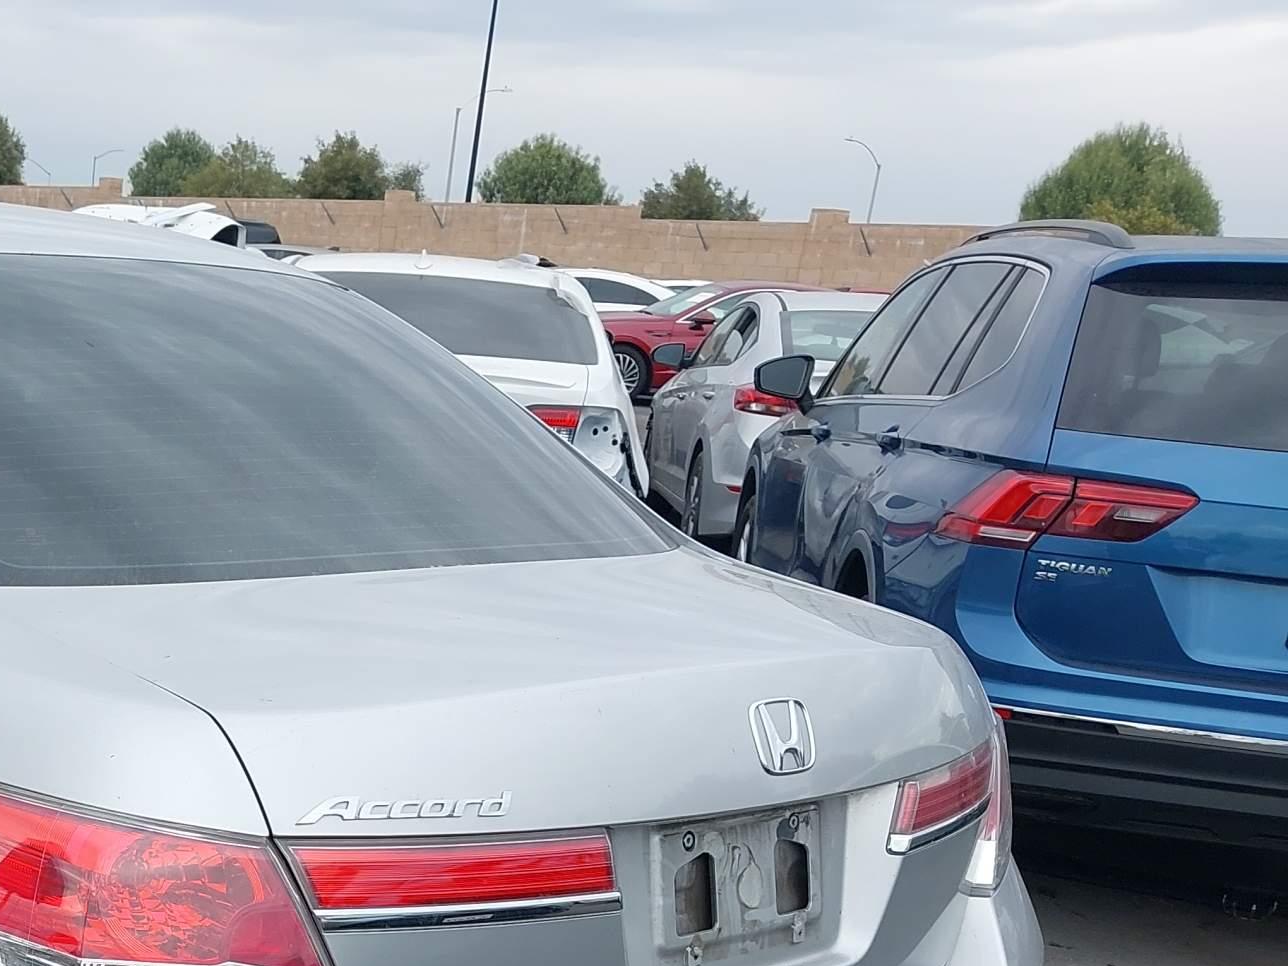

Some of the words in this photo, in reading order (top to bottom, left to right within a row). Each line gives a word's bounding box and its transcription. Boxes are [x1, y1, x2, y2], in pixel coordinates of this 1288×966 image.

[1033, 571, 1058, 582] SE
[1037, 559, 1113, 577] TIGUAN
[294, 789, 513, 826] Accord
